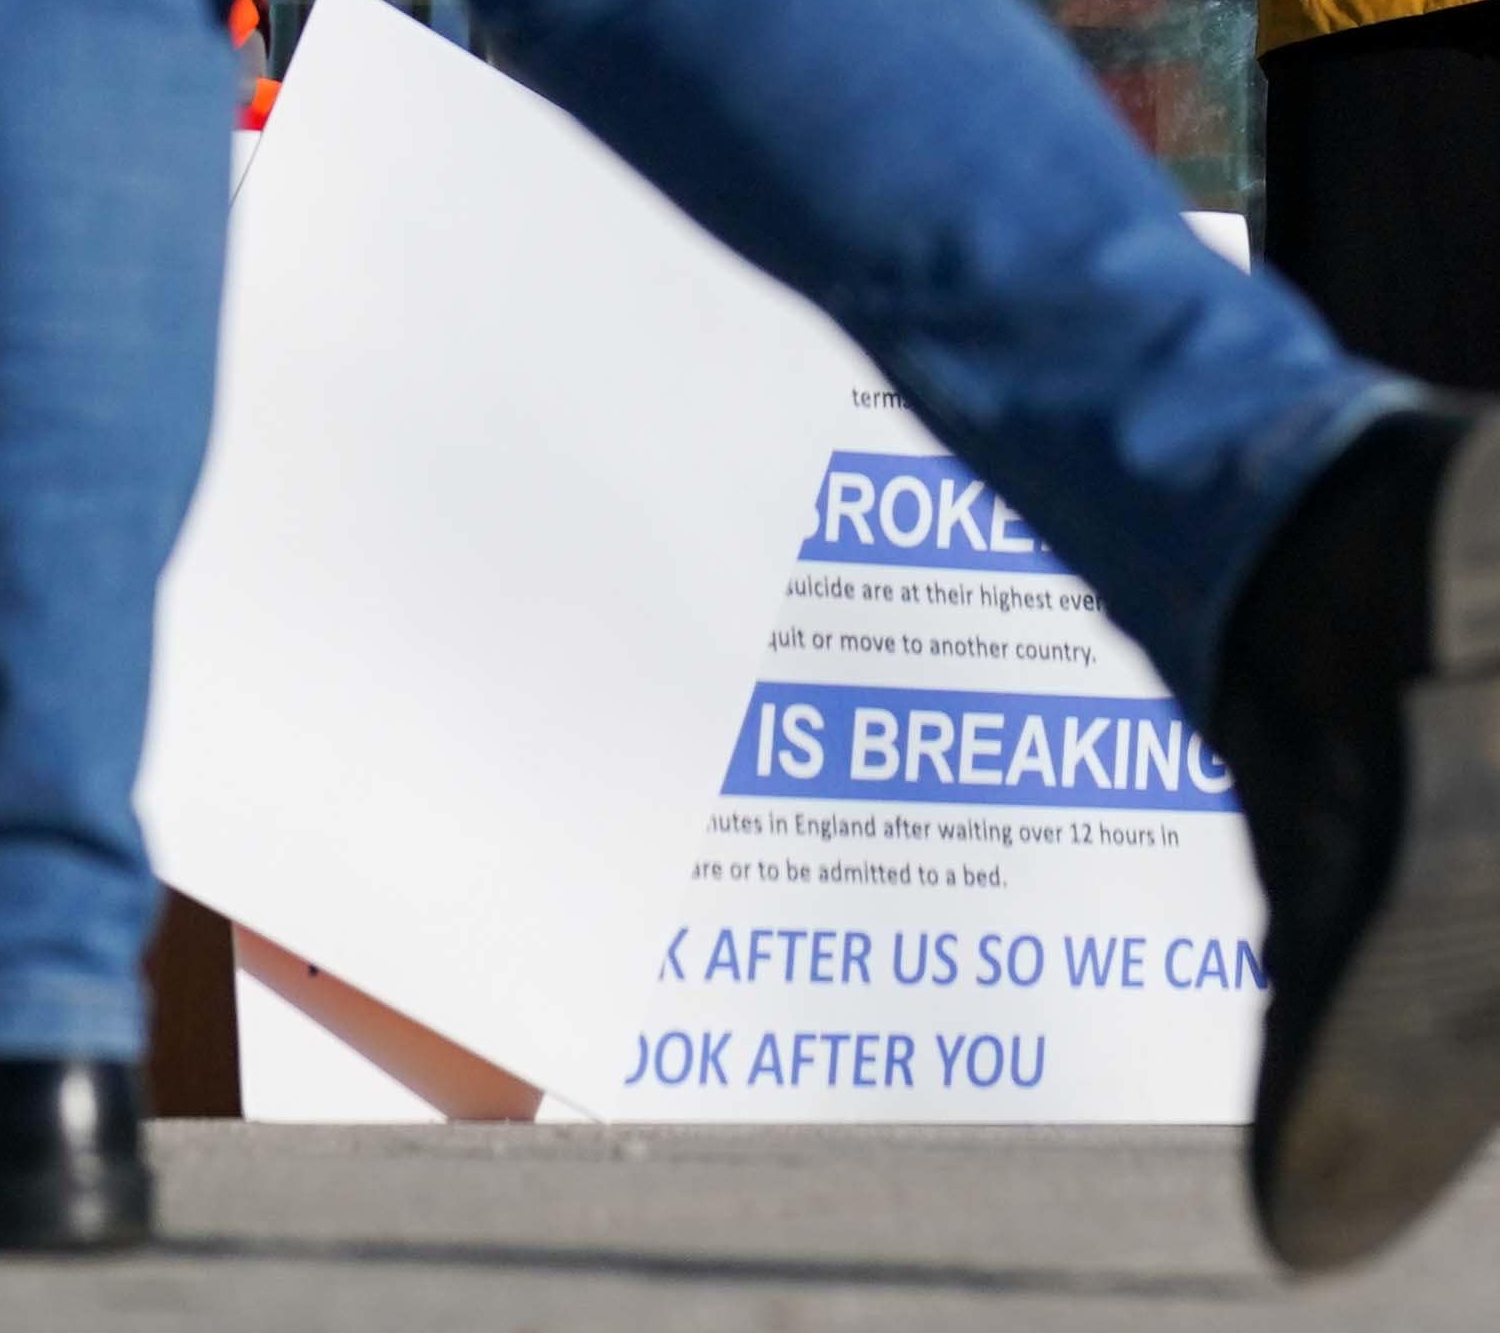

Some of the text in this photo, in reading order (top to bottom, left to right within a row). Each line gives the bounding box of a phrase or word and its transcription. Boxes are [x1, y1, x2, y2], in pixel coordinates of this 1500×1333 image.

[804, 471, 1052, 553] ROKE
[863, 581, 893, 602] are
[901, 582, 920, 603] at
[926, 583, 973, 607] their
[980, 583, 1053, 613] highest
[812, 632, 832, 650] or
[840, 635, 895, 652] move
[902, 634, 923, 654] to
[930, 635, 1008, 659] another
[1015, 640, 1098, 667] country.
[756, 702, 1236, 794] IS BREAKING
[769, 811, 788, 834] in
[795, 813, 876, 841] England
[884, 817, 930, 840] after
[937, 819, 1013, 848] waiting
[1019, 825, 1062, 844] over
[1071, 823, 1093, 845] 12
[1100, 824, 1156, 847] hours
[1161, 823, 1180, 847] in
[730, 861, 751, 881] or
[758, 861, 780, 881] to
[786, 859, 811, 883] be
[818, 858, 912, 886] admitted
[918, 865, 939, 887] to
[946, 869, 957, 887] a
[963, 863, 1008, 888] bed.
[704, 927, 873, 984] AFTER
[893, 931, 960, 986] US
[976, 933, 1045, 988] SO
[1063, 935, 1147, 989] WE
[1164, 937, 1268, 991] CAN
[746, 1031, 916, 1089] AFTER
[935, 1033, 1046, 1089] YOU
